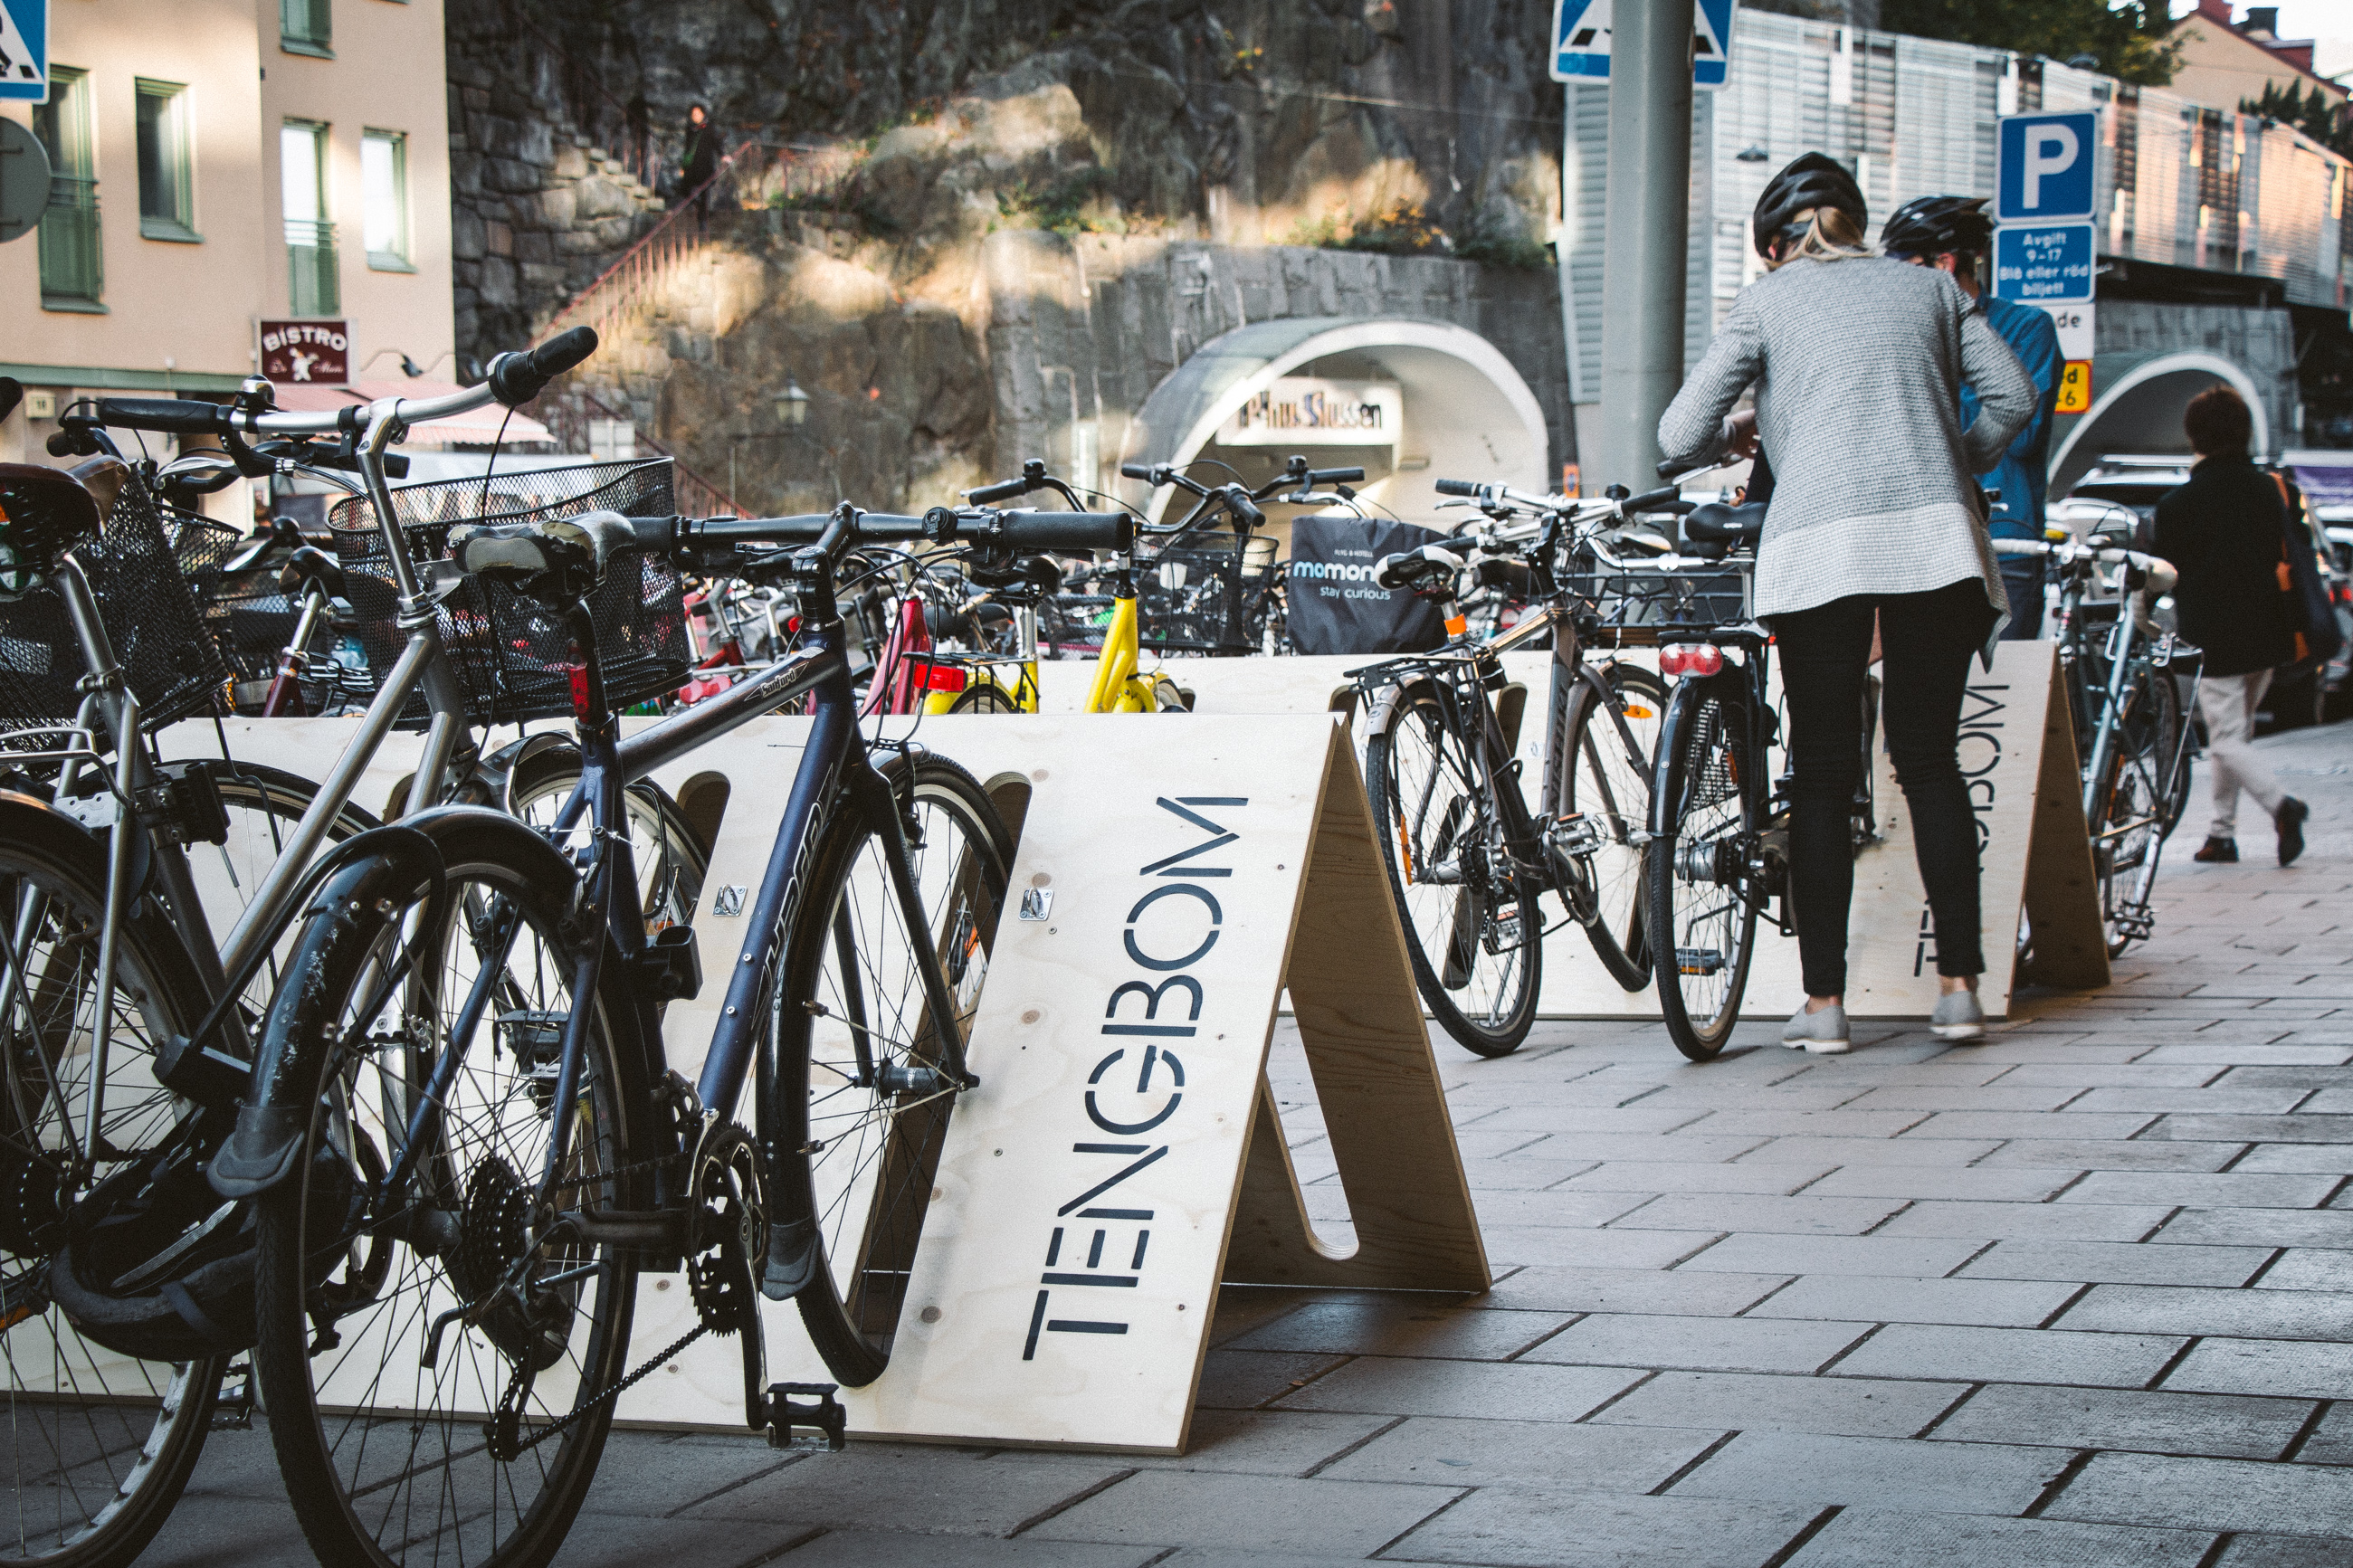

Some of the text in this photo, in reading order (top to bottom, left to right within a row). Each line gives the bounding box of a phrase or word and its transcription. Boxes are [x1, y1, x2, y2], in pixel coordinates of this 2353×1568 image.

[2023, 124, 2080, 209] P
[2023, 232, 2067, 249] Avgift
[2026, 266, 2059, 279] eller
[2022, 281, 2064, 298] biljett
[2057, 311, 2081, 328] de
[1292, 561, 1377, 582] momon
[1320, 586, 1391, 601] stay curious
[1023, 795, 1250, 1362] TENGBOM
